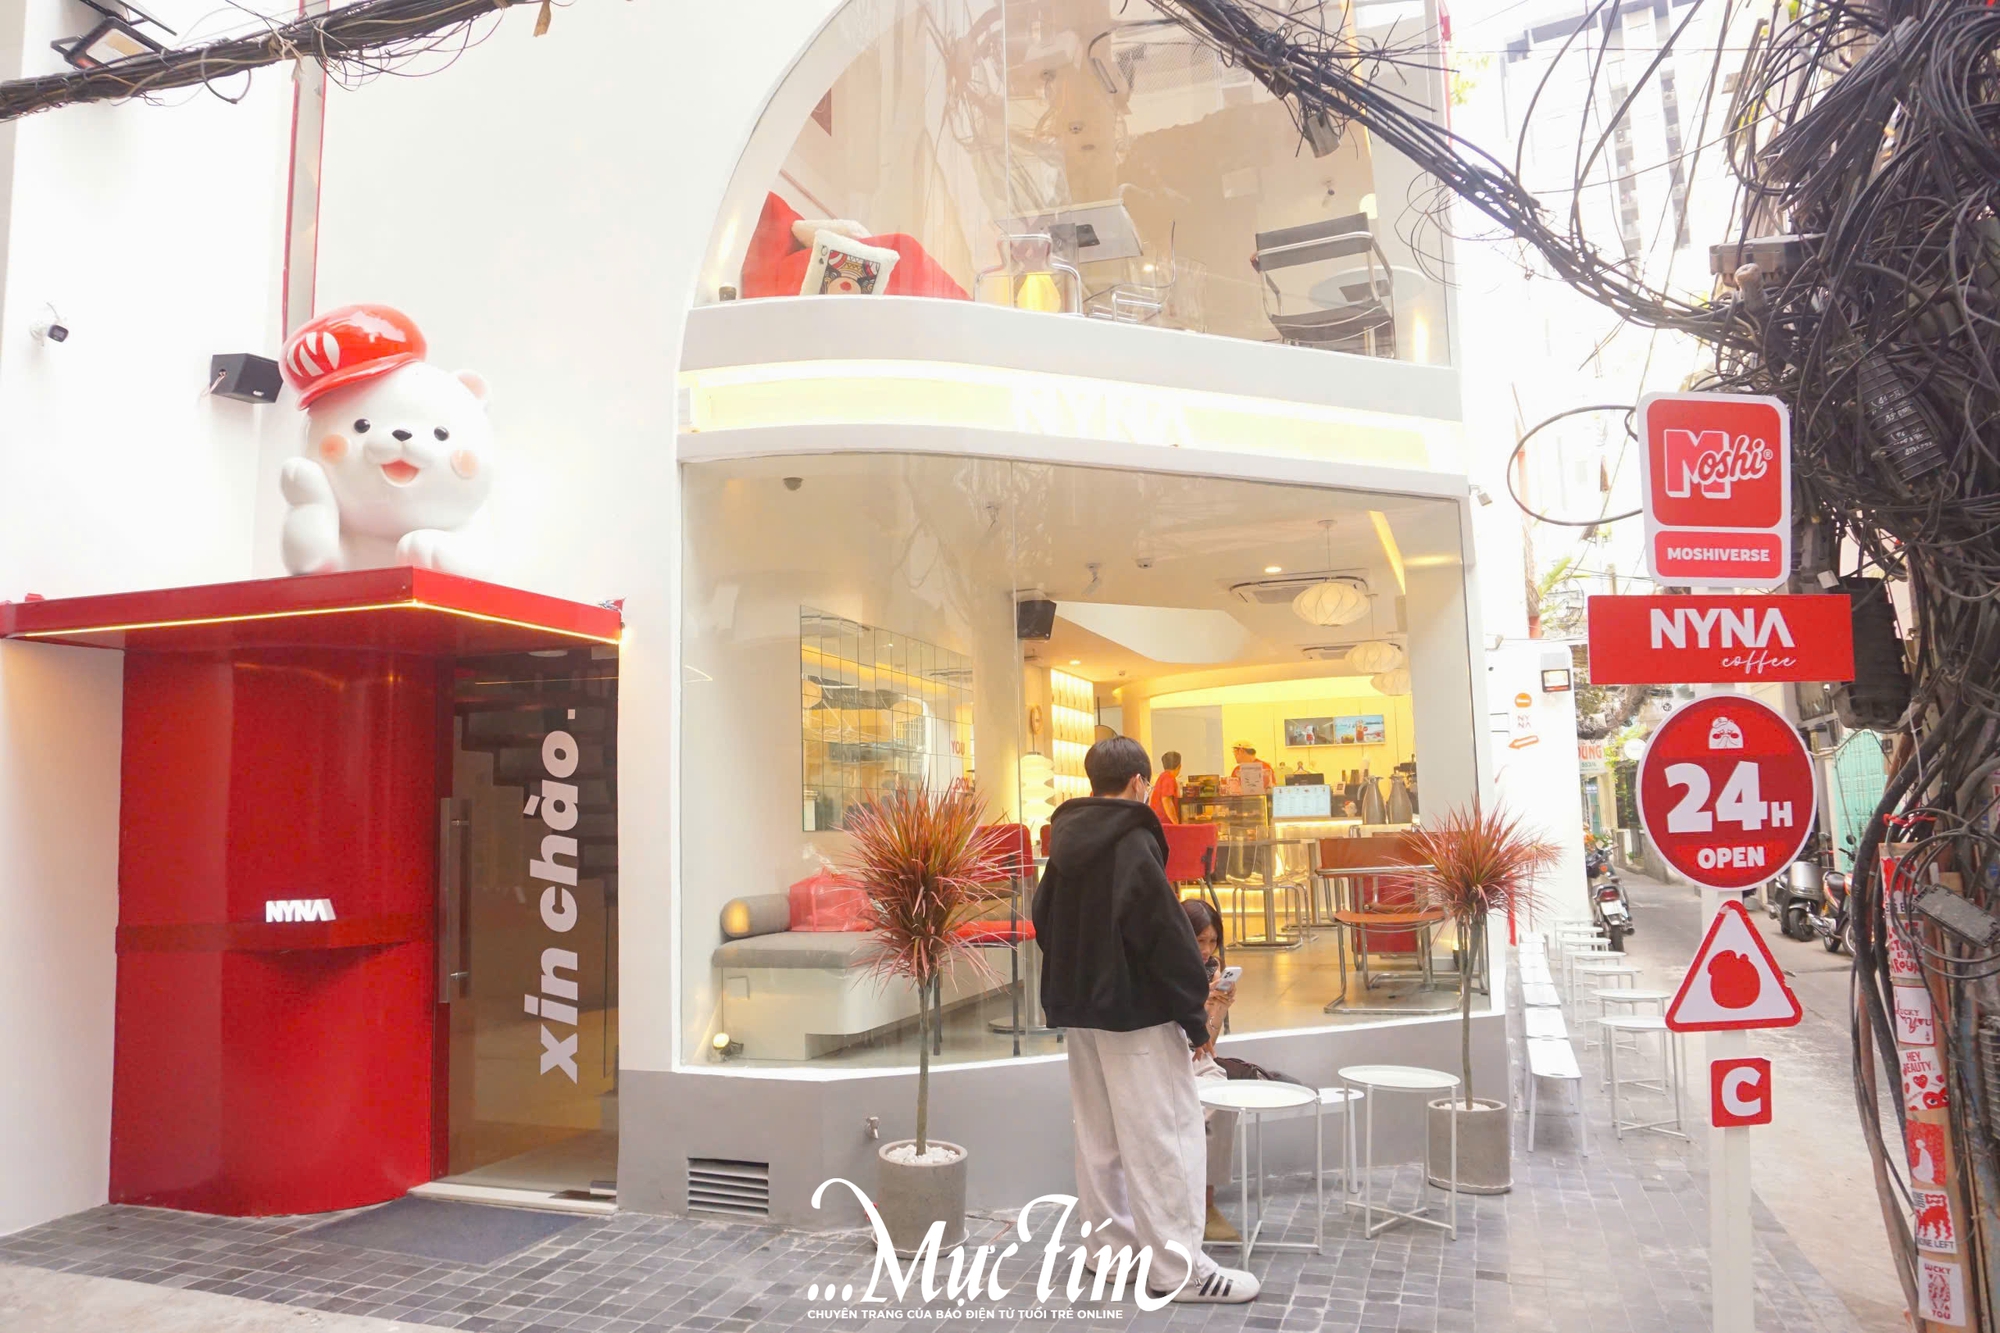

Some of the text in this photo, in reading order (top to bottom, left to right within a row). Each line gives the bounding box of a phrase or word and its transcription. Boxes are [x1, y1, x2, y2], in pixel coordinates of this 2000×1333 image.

[1667, 547, 1770, 562] MOSHIVERSE
[1650, 608, 1795, 649] NYNA
[1722, 650, 1797, 674] coffee
[1698, 845, 1765, 870] OPEN
[265, 899, 336, 923] NYNA
[524, 947, 578, 1085] xin
[1906, 1051, 1921, 1062] HEY
[1721, 1066, 1762, 1117] C
[1934, 1240, 1955, 1250] LEFT
